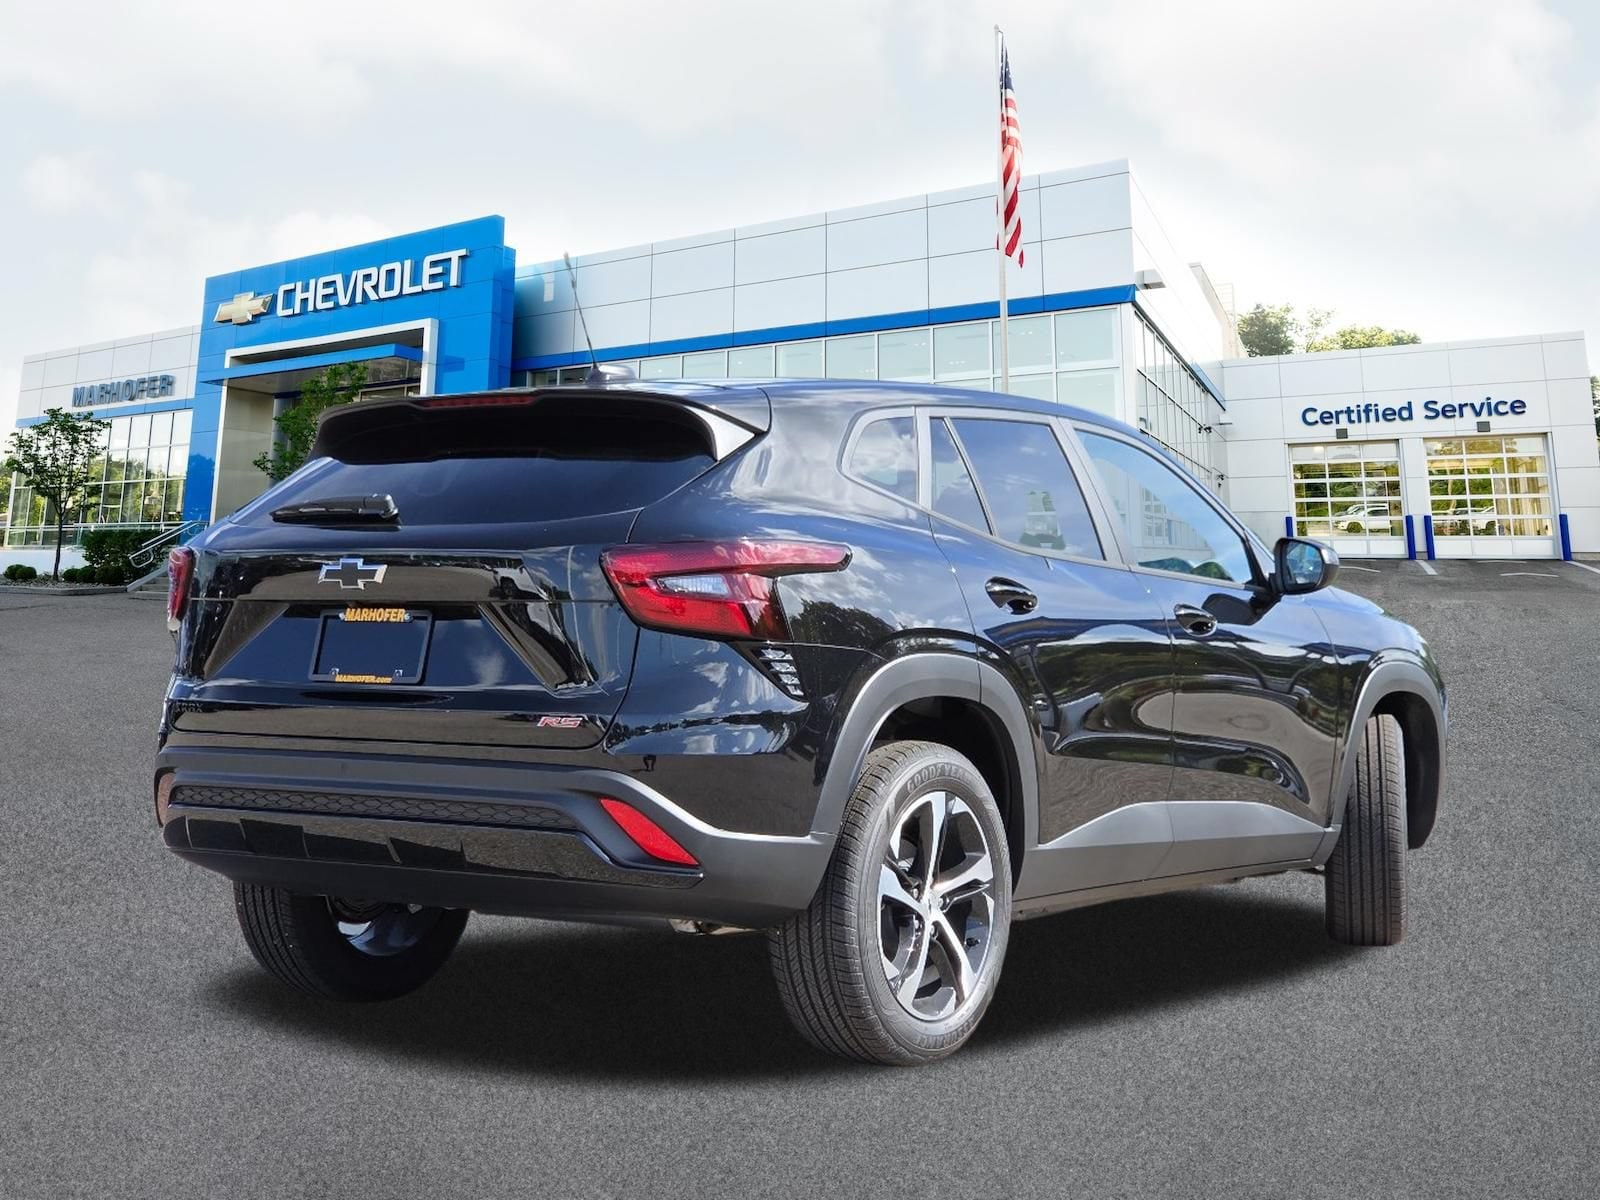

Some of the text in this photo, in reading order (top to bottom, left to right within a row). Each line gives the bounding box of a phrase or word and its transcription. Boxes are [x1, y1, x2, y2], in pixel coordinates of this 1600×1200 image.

[276, 248, 470, 317] CHEVROLET
[72, 375, 175, 407] MARHOFER
[1301, 397, 1527, 426] Certified Service
[344, 608, 406, 622] MARHOFER
[536, 716, 583, 728] RS
